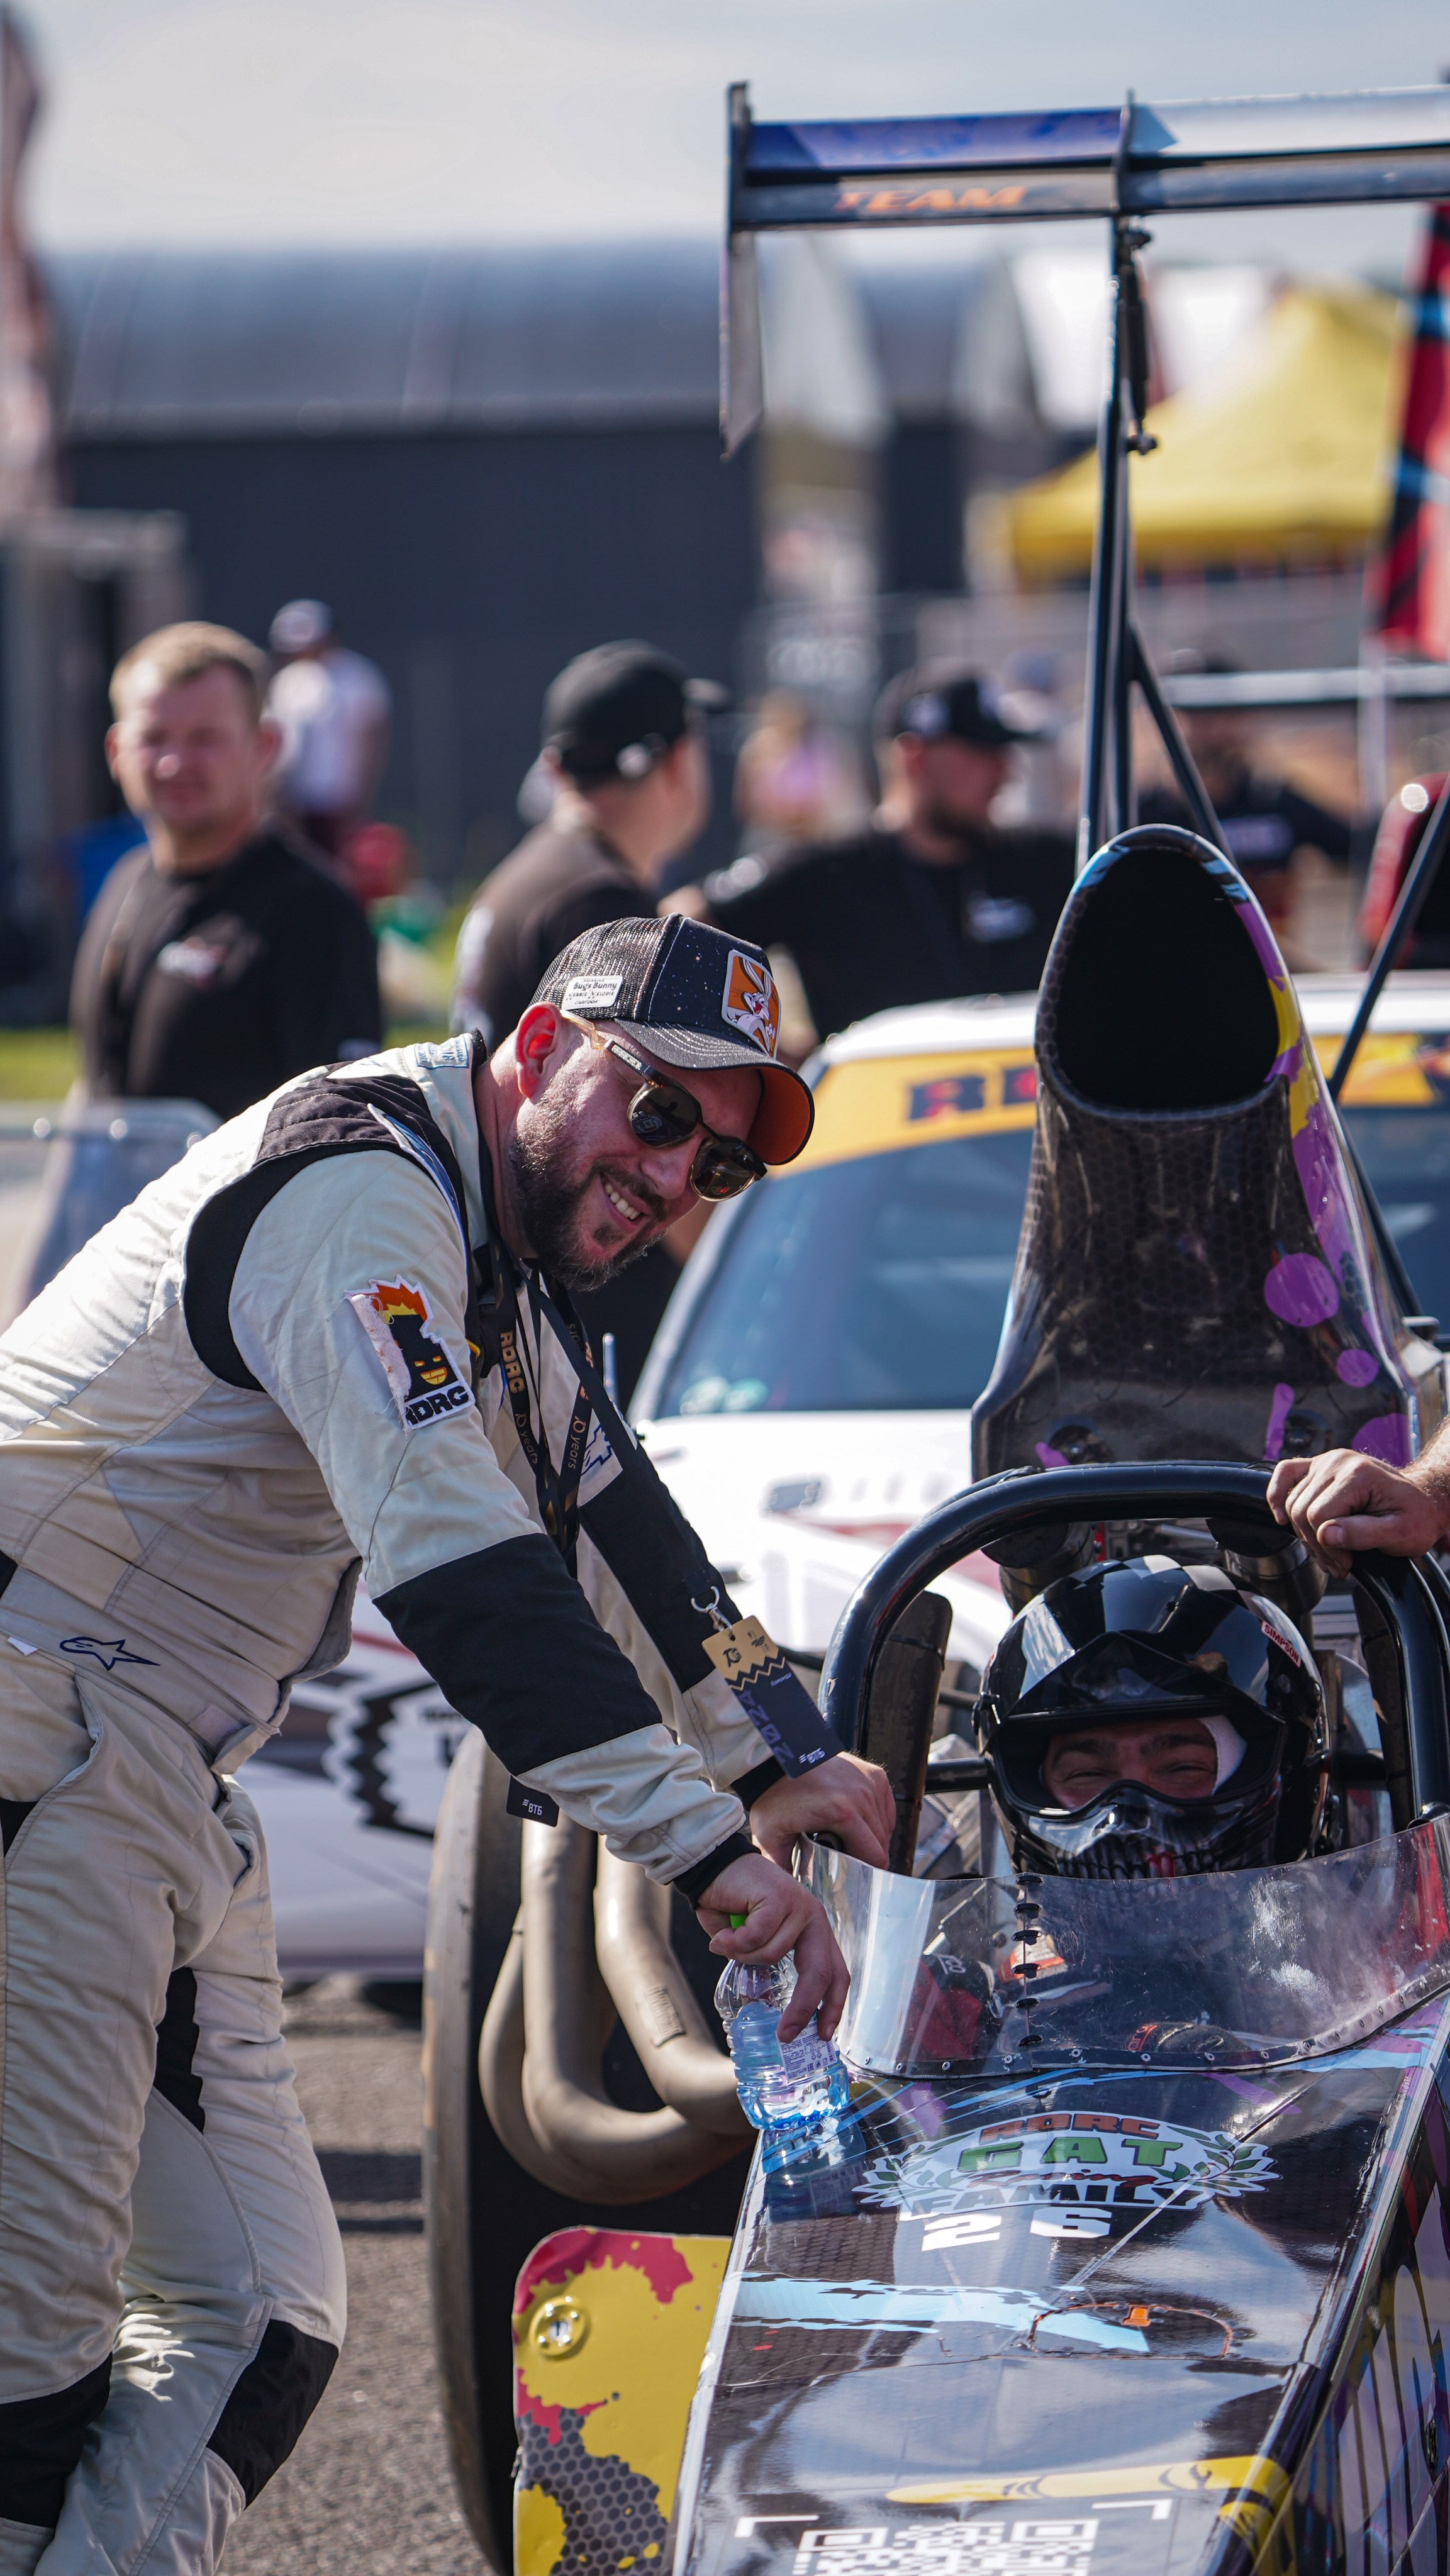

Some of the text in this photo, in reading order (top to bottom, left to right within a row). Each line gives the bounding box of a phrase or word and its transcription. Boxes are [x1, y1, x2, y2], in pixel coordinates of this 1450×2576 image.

[832, 186, 1026, 212] TEAM
[574, 982, 617, 991] Bugs Bunny
[520, 1431, 538, 1464] years
[568, 1435, 581, 1469] years
[1264, 1624, 1299, 1663] SIMPSON
[528, 1803, 542, 1816] ВТБ
[978, 2113, 1160, 2146] RDRC
[957, 2136, 1183, 2172] GAT
[910, 2184, 1205, 2216] FAMILY
[921, 2206, 1113, 2252] 26
